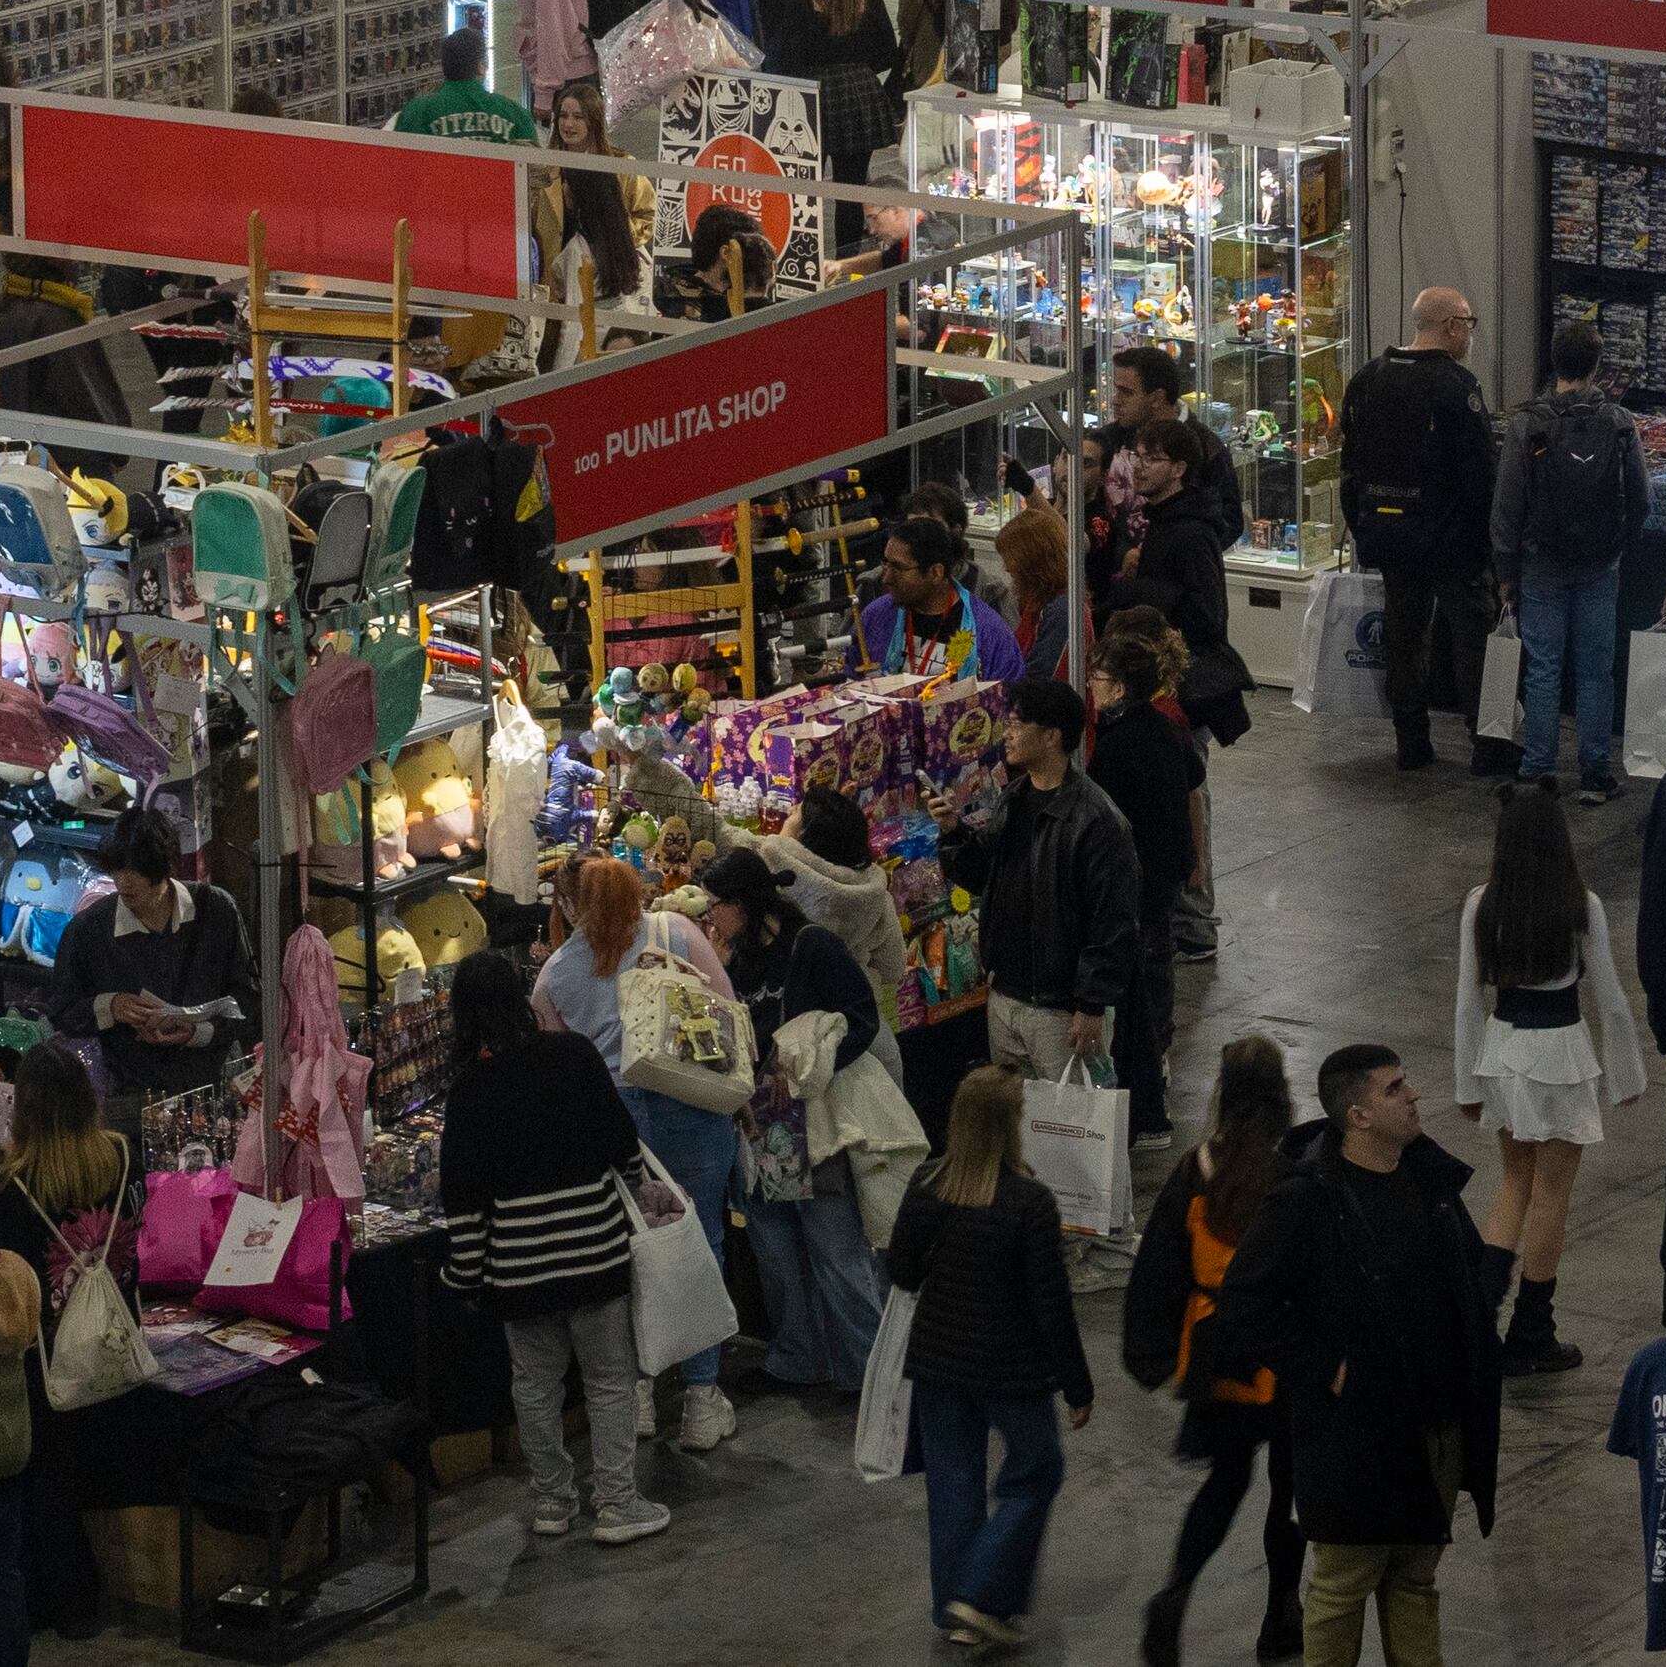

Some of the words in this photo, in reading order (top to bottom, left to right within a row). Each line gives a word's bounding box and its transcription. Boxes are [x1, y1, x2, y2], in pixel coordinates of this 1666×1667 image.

[711, 154, 746, 173] GO
[713, 183, 745, 205] KU
[574, 451, 600, 476] 100
[606, 401, 714, 464] PUNLITA
[717, 380, 787, 430] SHOP
[1086, 1129, 1106, 1142] Shop
